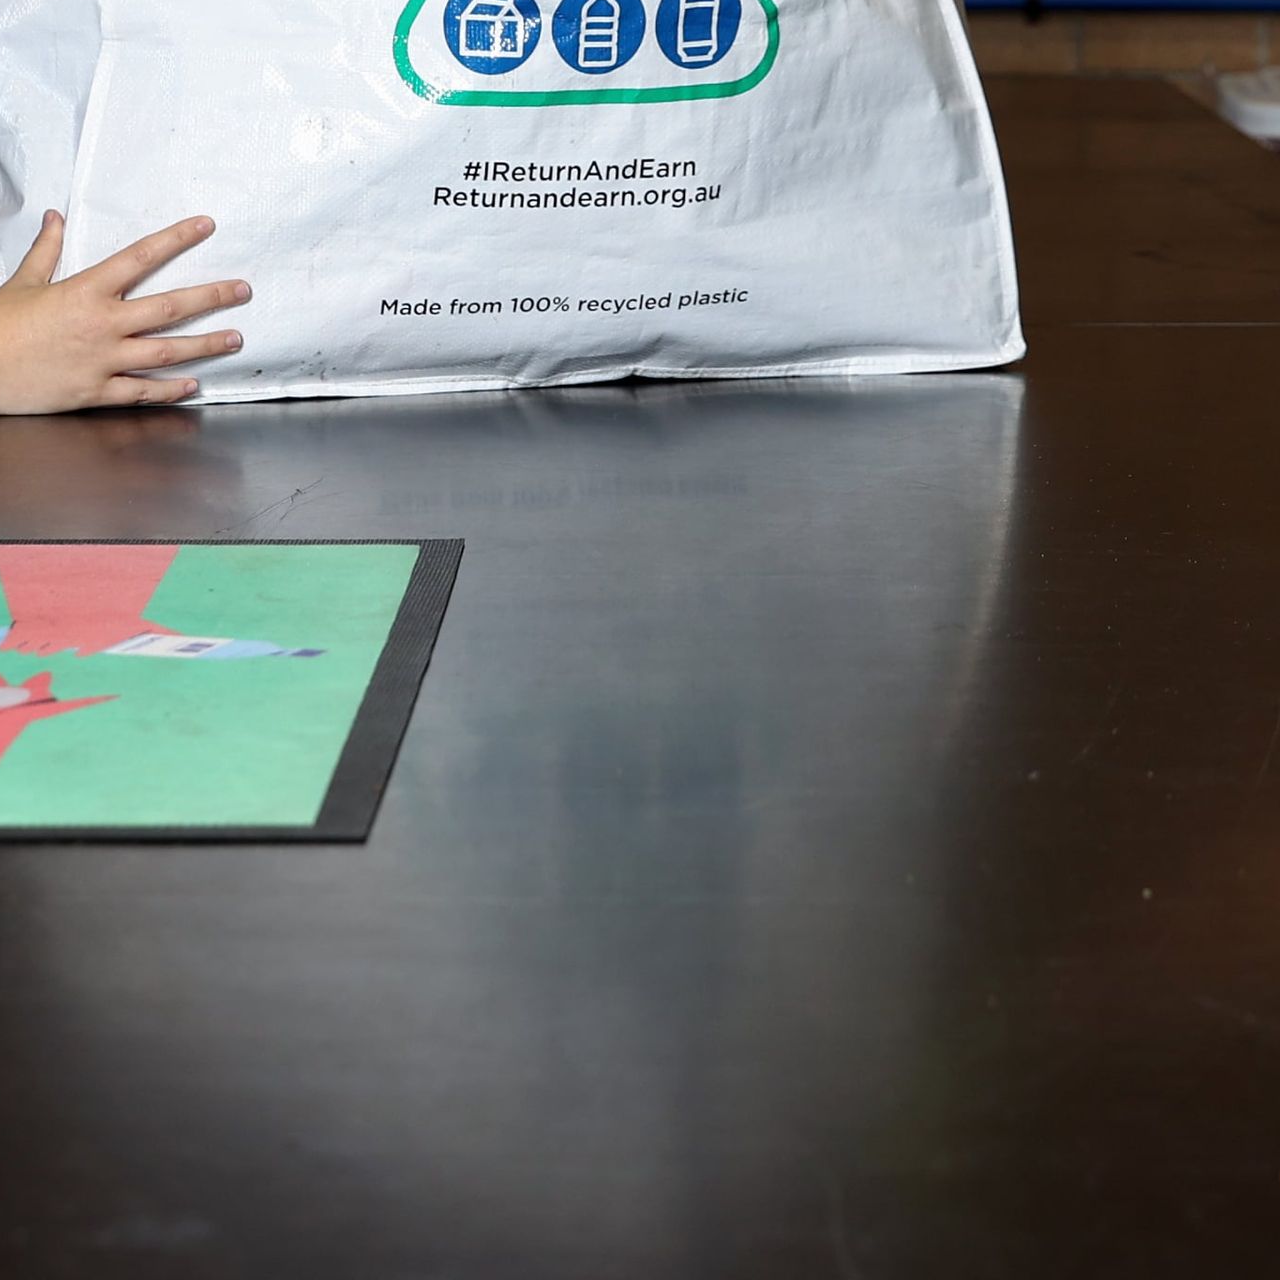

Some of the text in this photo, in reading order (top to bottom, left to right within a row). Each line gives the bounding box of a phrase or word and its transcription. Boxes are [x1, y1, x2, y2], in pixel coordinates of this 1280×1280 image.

[462, 158, 696, 182] #IReturnAndEarn
[432, 184, 722, 209] Returnandearn.org.au
[380, 288, 749, 316] Made from 100% recycled plastic
